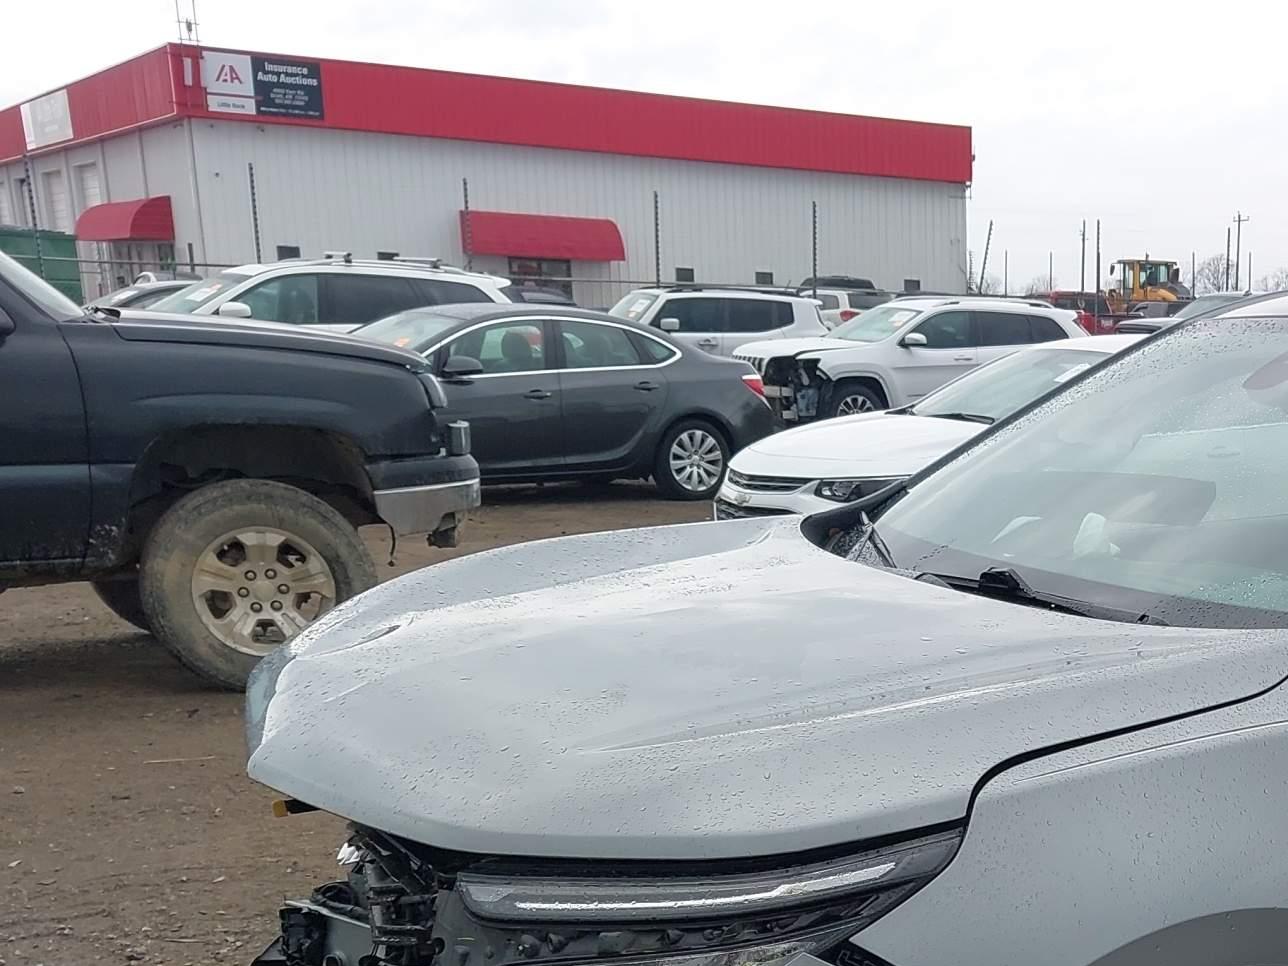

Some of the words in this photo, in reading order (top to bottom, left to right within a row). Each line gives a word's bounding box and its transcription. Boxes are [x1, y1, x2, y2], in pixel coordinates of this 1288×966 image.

[264, 61, 308, 75] Insurance
[257, 71, 278, 83] Auto
[279, 73, 318, 86] Auctions
